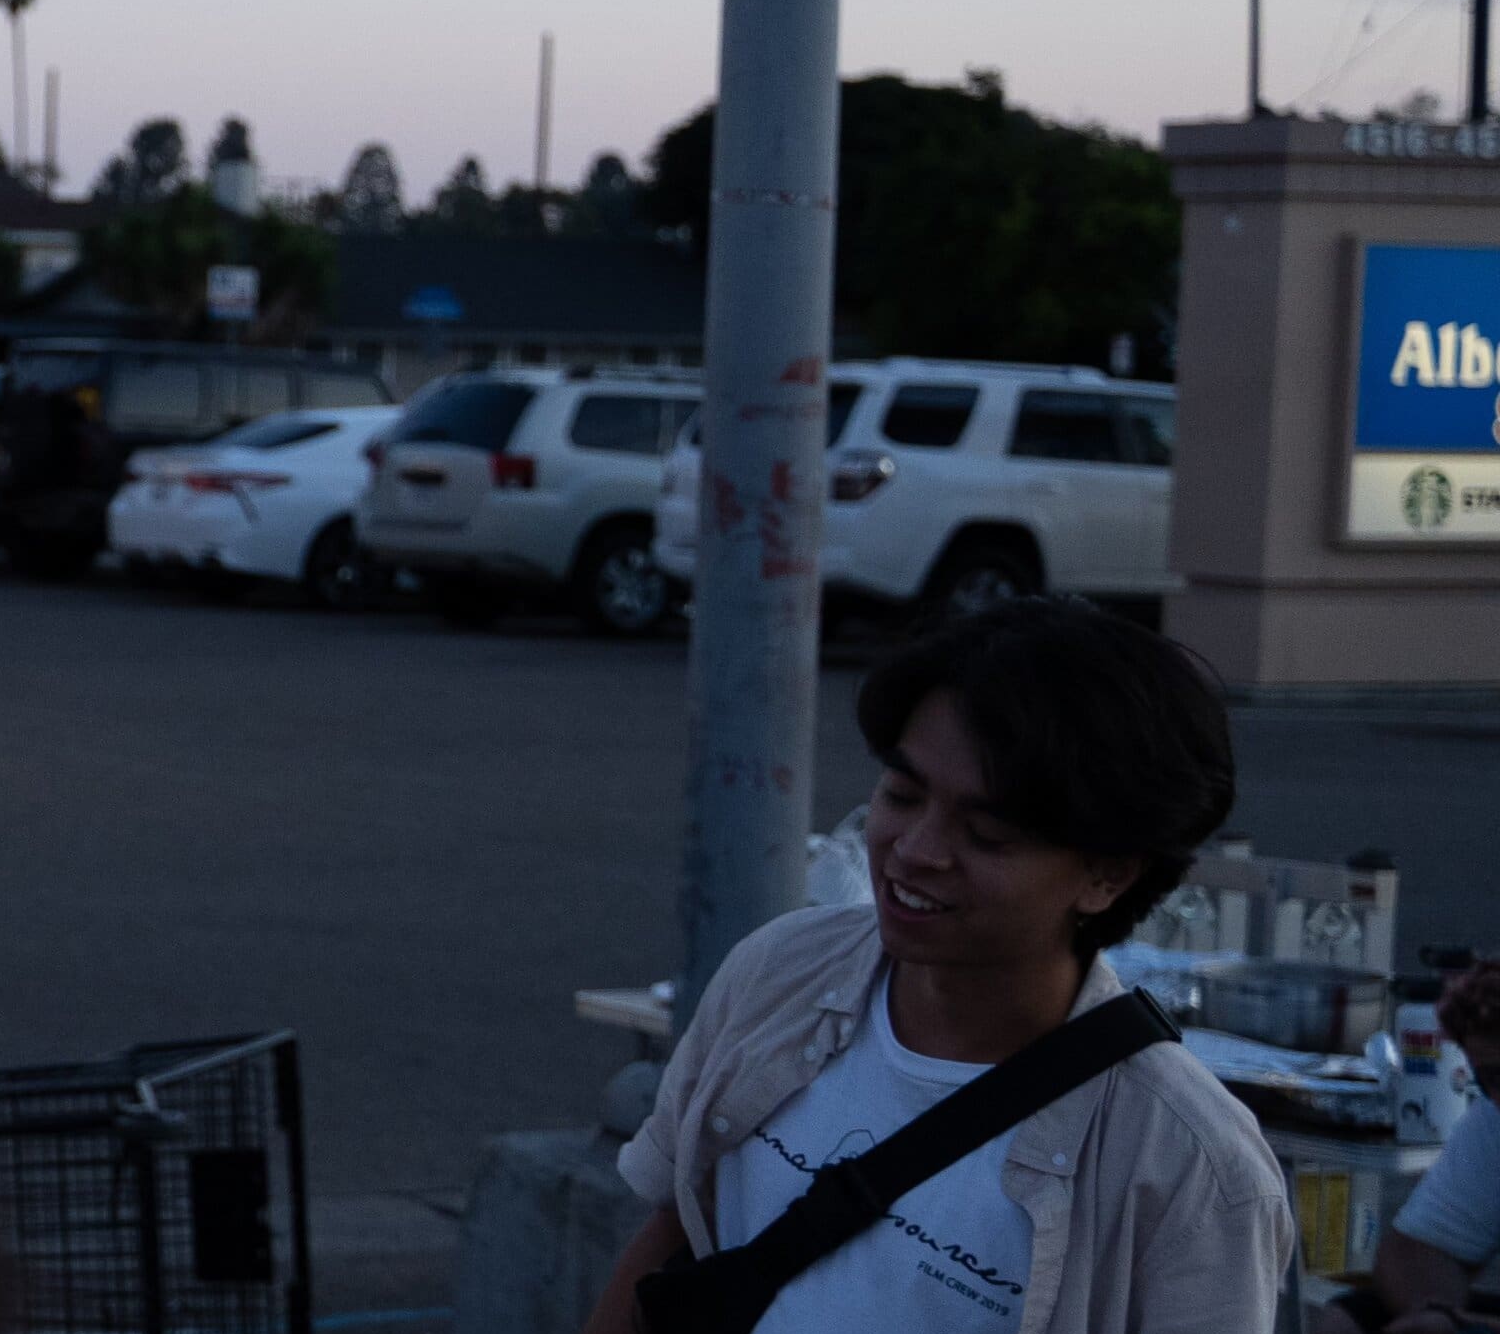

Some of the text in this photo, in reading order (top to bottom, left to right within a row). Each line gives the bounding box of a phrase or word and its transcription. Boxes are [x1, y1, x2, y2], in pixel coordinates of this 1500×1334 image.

[1390, 320, 1500, 388] Alb
[916, 1259, 946, 1284] FILM
[945, 1276, 980, 1301] CREW
